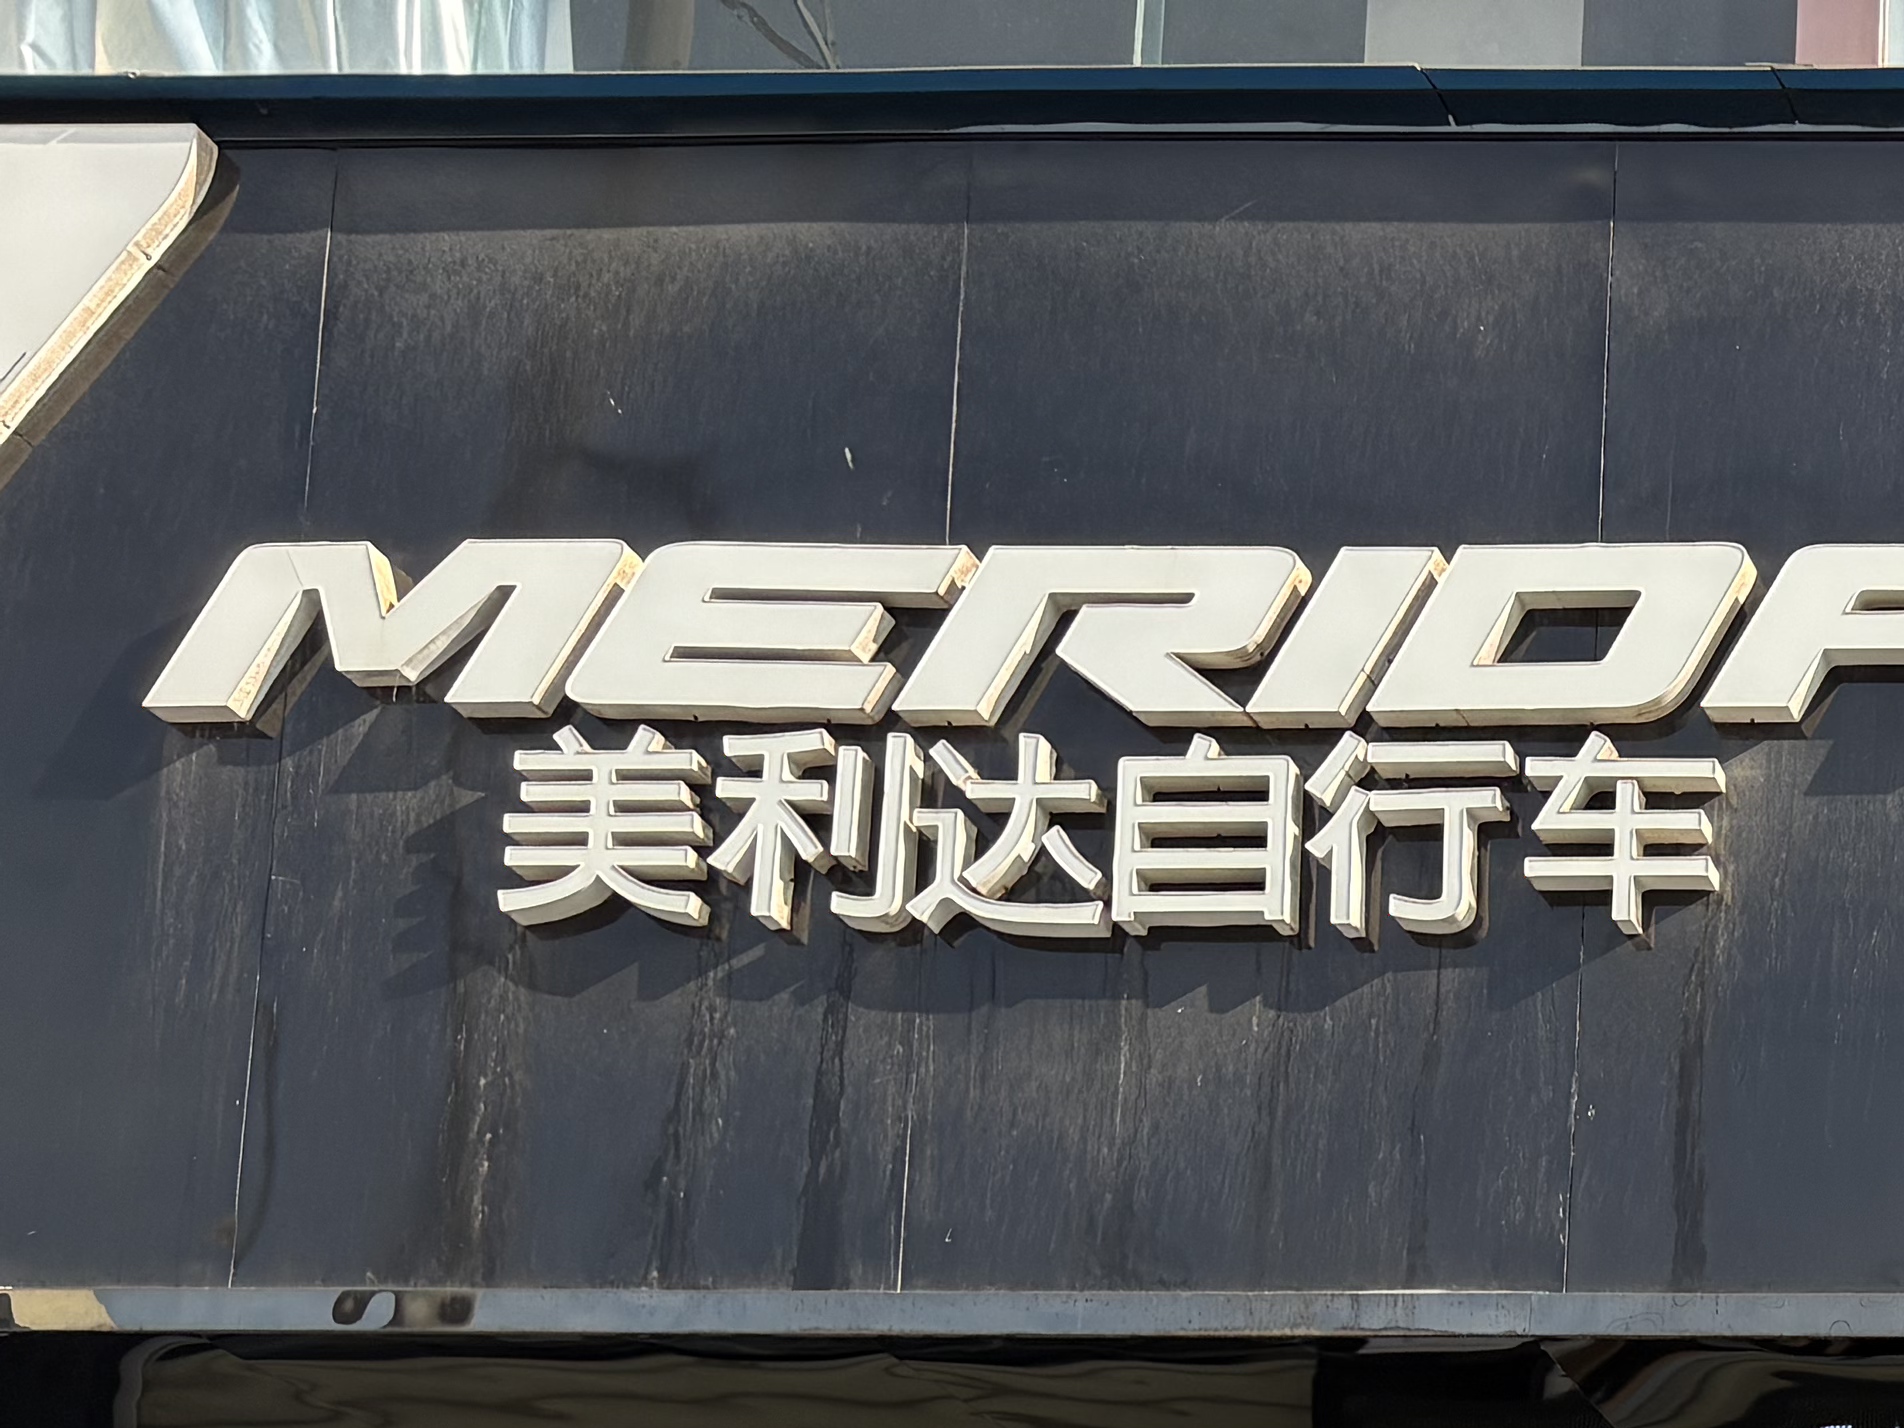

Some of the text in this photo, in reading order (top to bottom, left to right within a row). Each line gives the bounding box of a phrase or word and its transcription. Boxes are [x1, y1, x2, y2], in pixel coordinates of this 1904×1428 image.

[494, 725, 1728, 939] 美利达自行车
